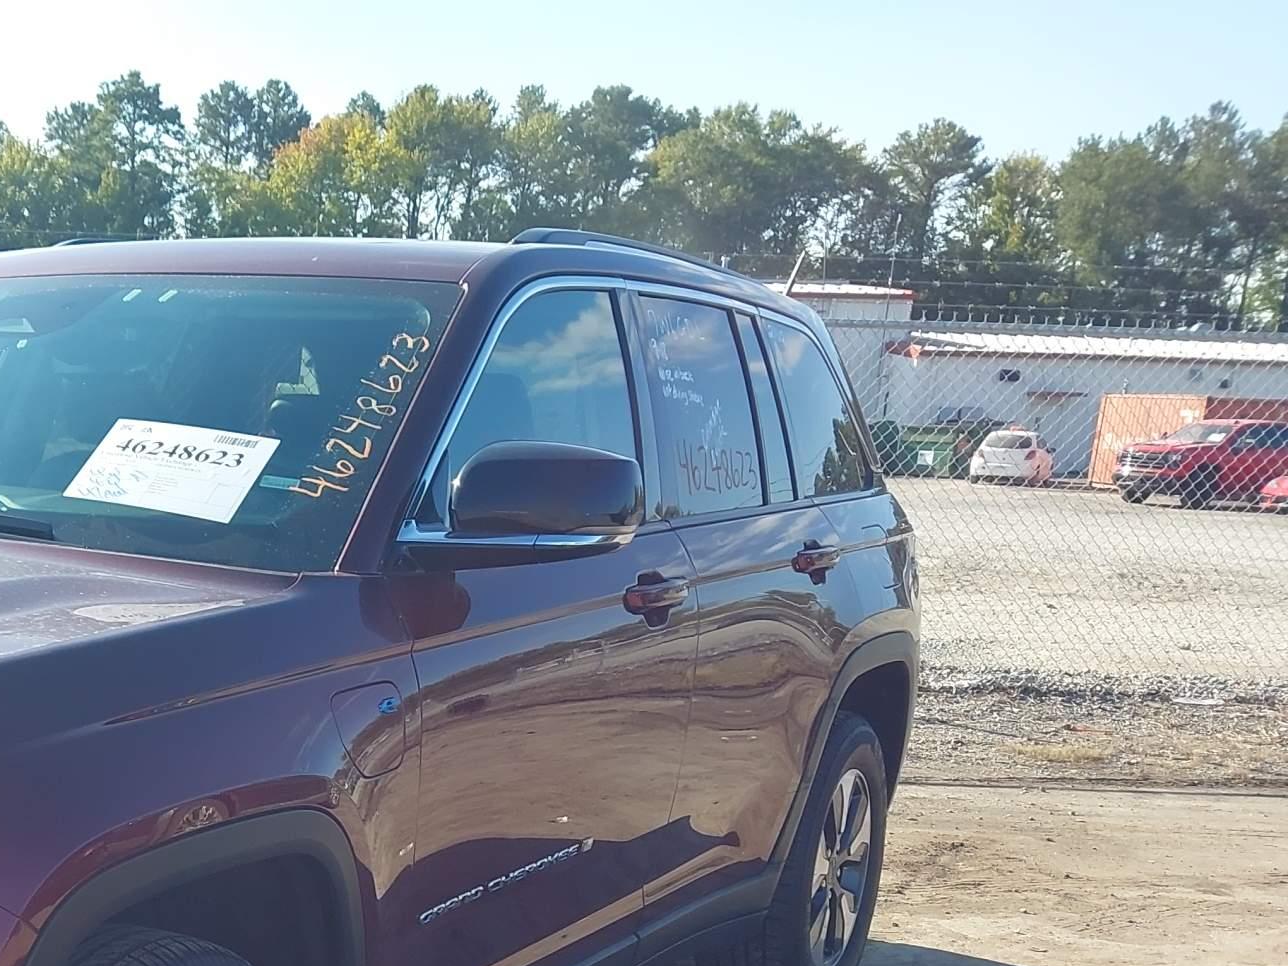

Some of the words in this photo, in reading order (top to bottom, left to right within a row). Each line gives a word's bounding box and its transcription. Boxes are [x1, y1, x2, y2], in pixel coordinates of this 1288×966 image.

[289, 332, 431, 498] 46248623
[115, 437, 246, 469] 46248623
[676, 439, 758, 496] 46248623
